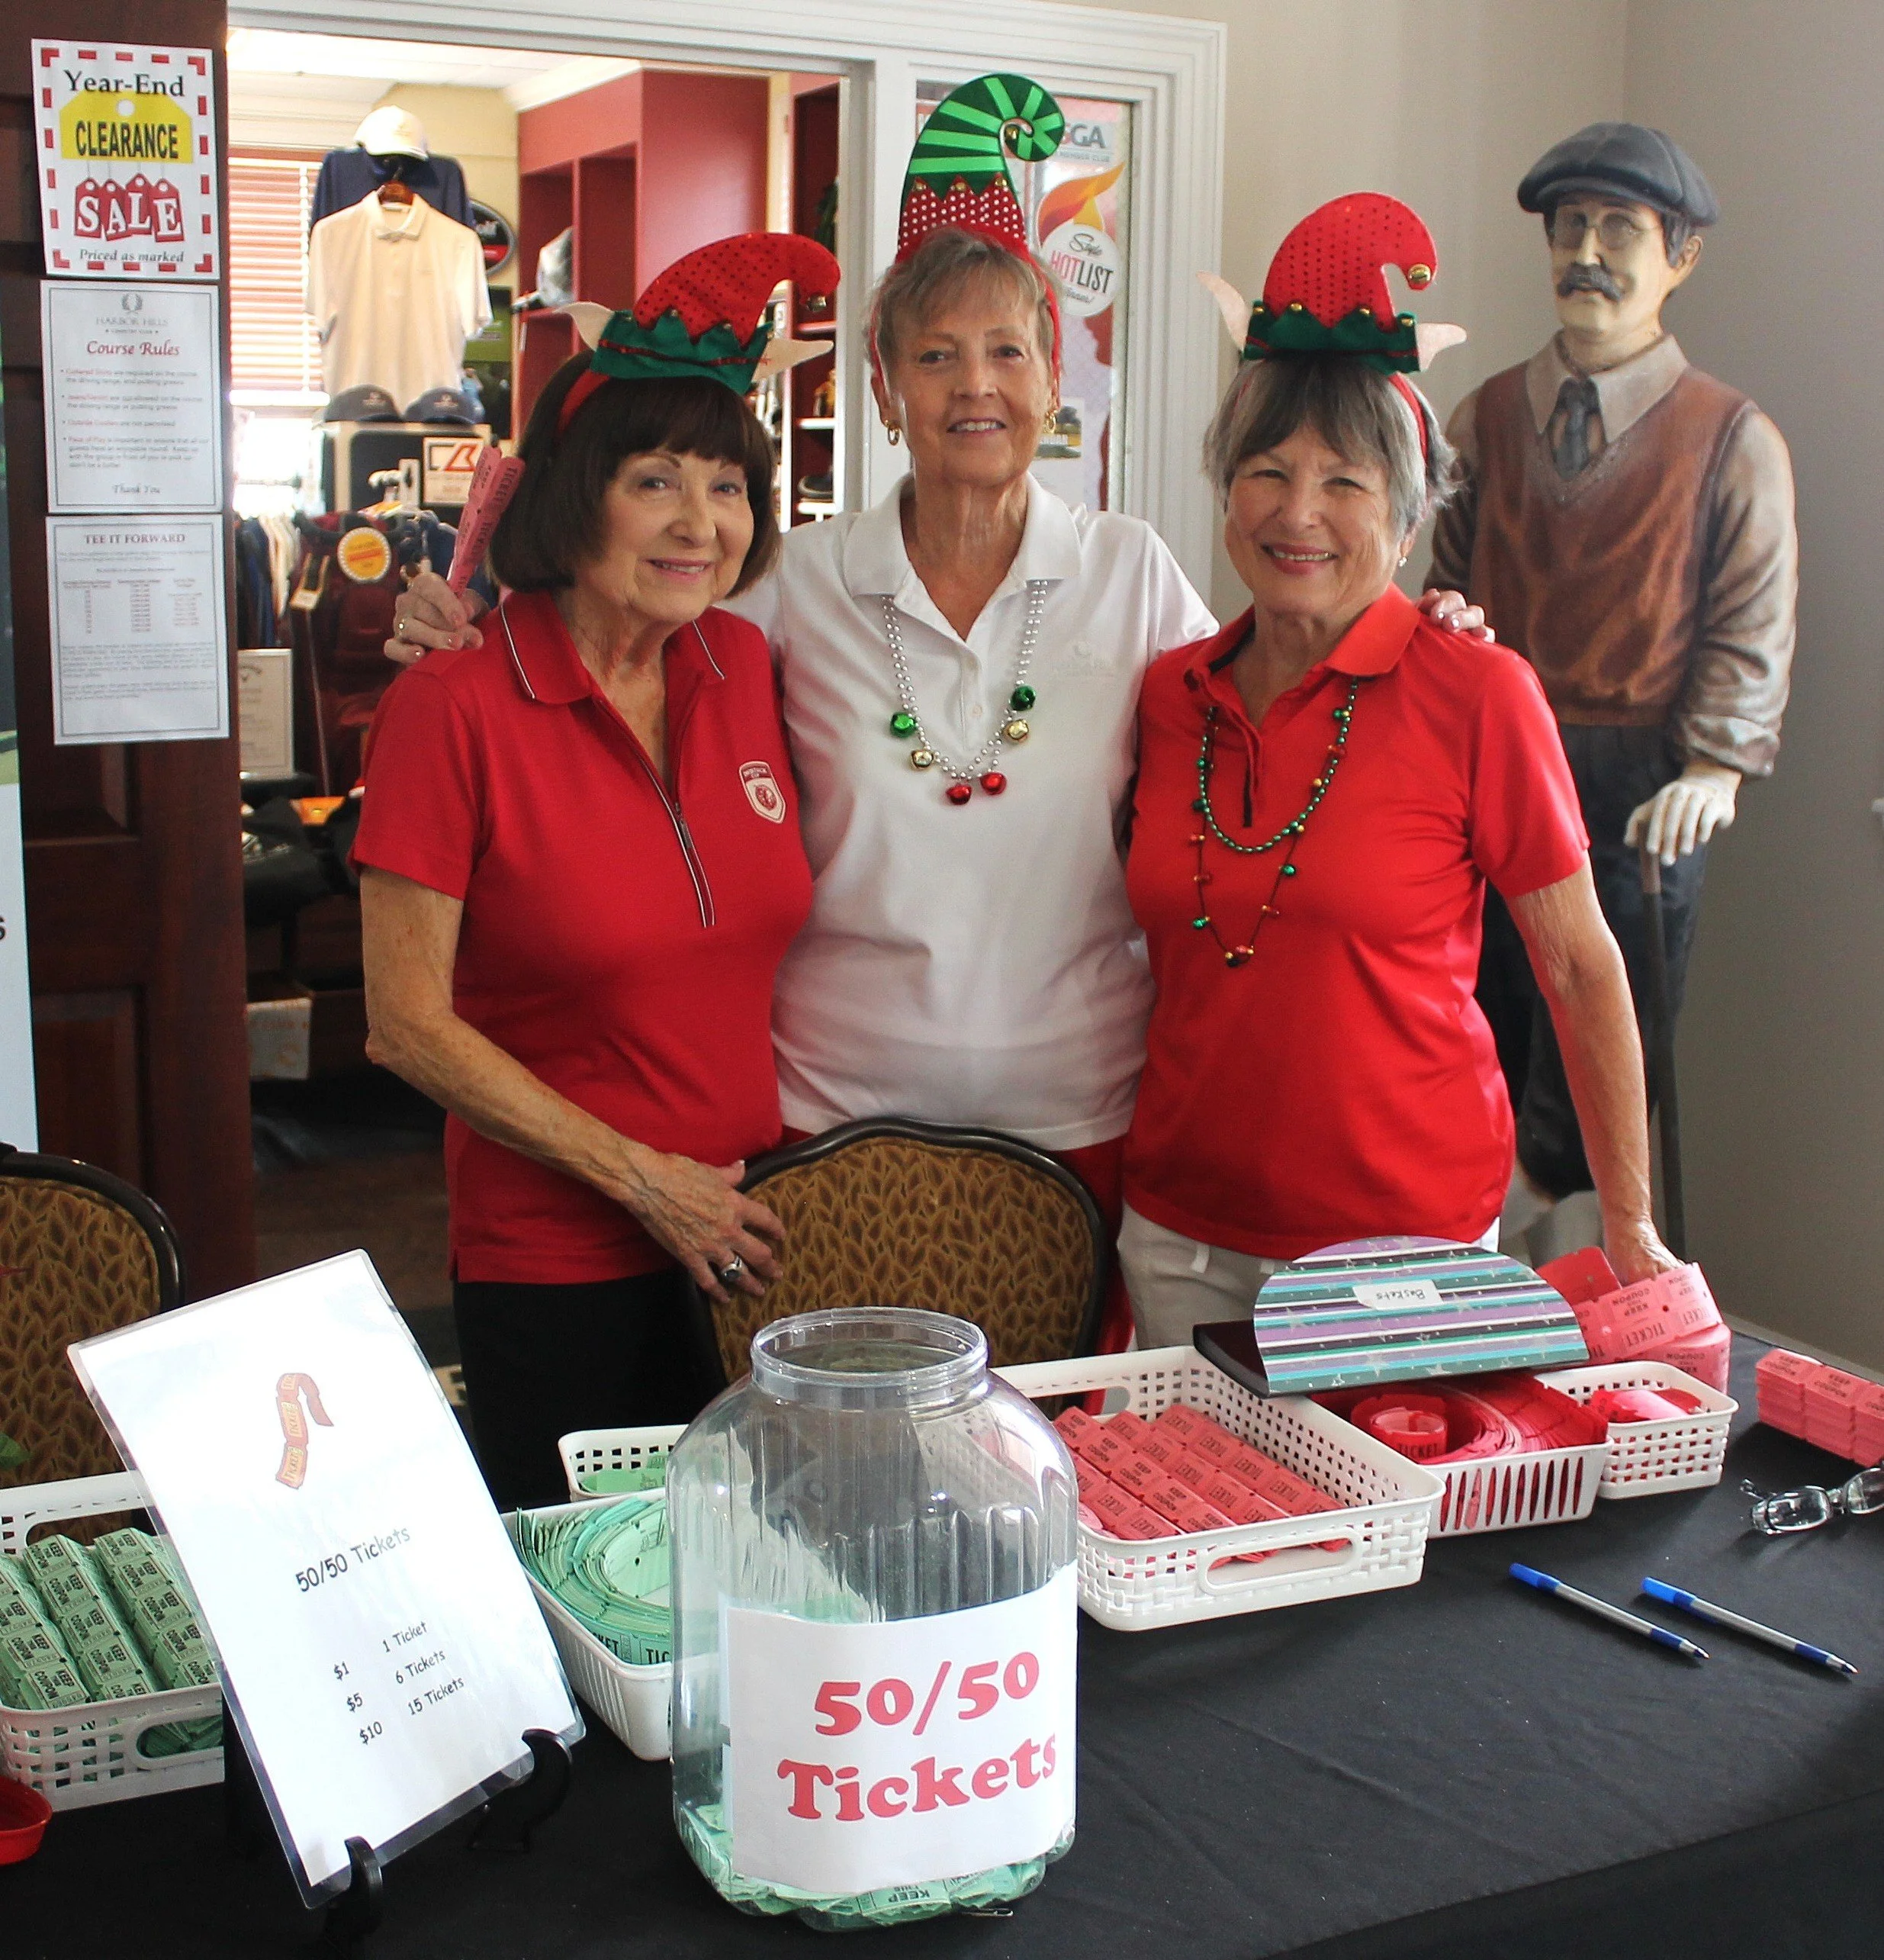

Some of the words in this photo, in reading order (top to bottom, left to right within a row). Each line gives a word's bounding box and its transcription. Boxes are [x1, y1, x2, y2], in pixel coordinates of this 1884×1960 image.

[63, 69, 185, 96] Year-End
[76, 120, 179, 159] CLEARANCE
[77, 191, 182, 237] SALE
[79, 249, 117, 262] Priced
[121, 252, 135, 262] as
[138, 249, 185, 262] marked
[87, 340, 135, 355] Course
[140, 339, 181, 356] Rules
[85, 534, 106, 545] TEE
[109, 533, 121, 544] IT
[124, 533, 186, 544] FORWARD
[1612, 1287, 1651, 1305] COUPON
[1626, 1322, 1667, 1347] TICKET
[295, 1553, 349, 1592] 50/50
[349, 1527, 411, 1564] Tickets
[333, 1660, 350, 1682] $1
[382, 1639, 391, 1653] 1
[392, 1620, 427, 1646] Ticket
[346, 1691, 363, 1713] $5
[395, 1669, 404, 1685] 6
[404, 1649, 446, 1678] Tickets
[814, 1650, 1040, 1736] 50/50
[359, 1720, 383, 1746] $10
[407, 1697, 423, 1716] 15
[423, 1677, 465, 1705] Tickets
[776, 1732, 1056, 1822] Tickets
[888, 1888, 931, 1903] KEEP
